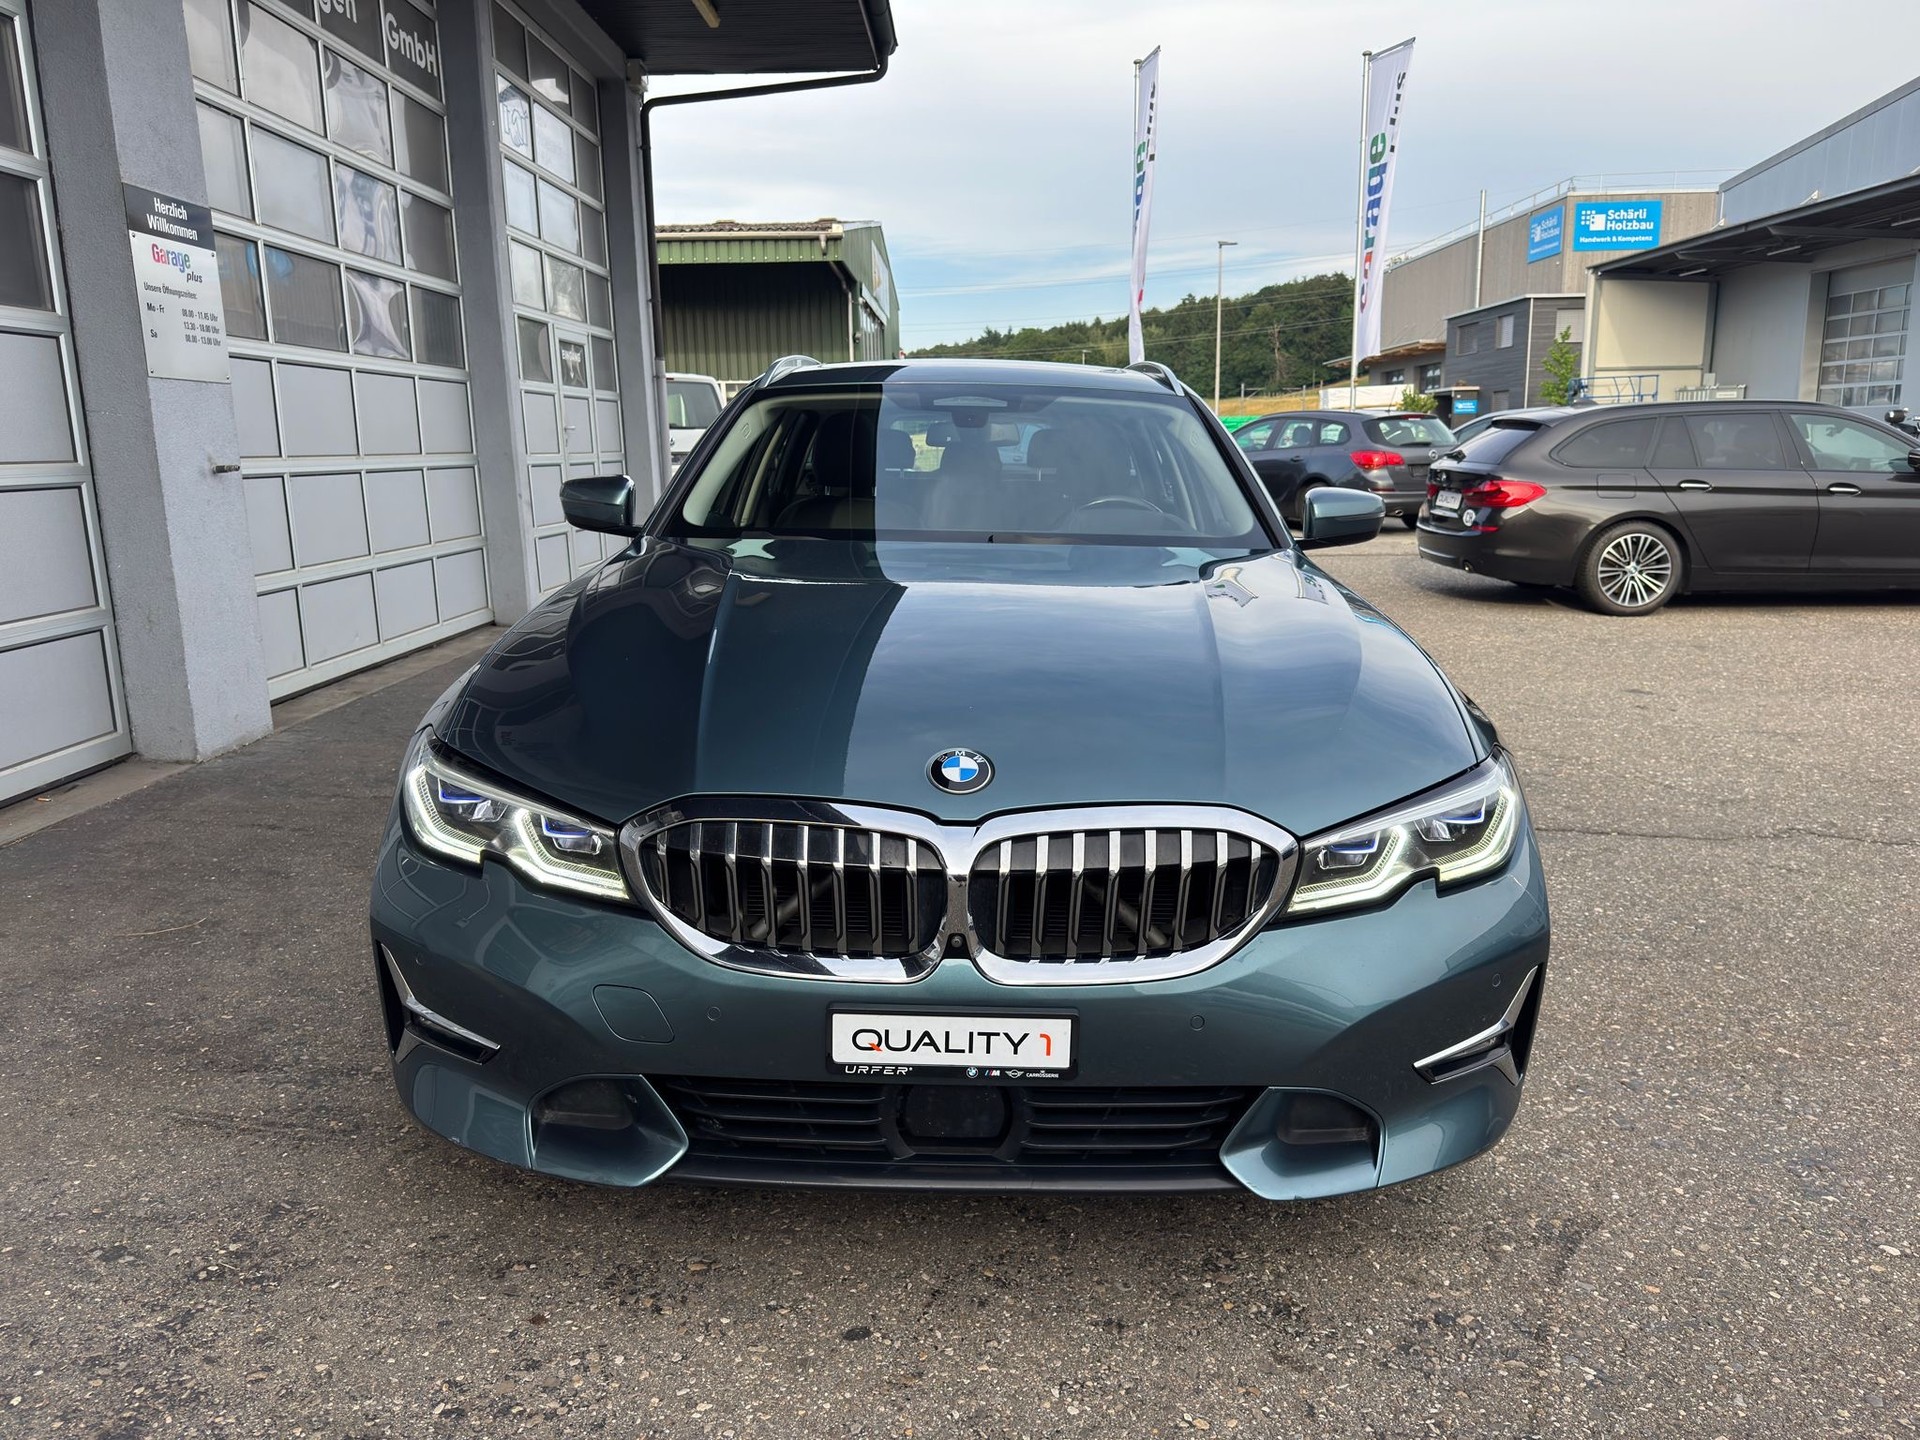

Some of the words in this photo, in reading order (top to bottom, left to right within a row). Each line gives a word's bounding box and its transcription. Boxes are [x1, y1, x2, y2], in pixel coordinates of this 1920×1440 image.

[385, 12, 438, 77] GmbH
[154, 197, 188, 220] Herzlich
[1607, 208, 1647, 220] Schärli
[146, 213, 198, 241] Willkommen
[1606, 221, 1654, 231] Holzbau
[1617, 235, 1653, 243] Kompetenz
[151, 243, 191, 273] Garage
[186, 271, 203, 284] plus
[143, 282, 162, 293] Unsere
[146, 302, 156, 312] Mo
[150, 329, 158, 339] Sa
[851, 1028, 1030, 1056] QUALITY
[1039, 1033, 1052, 1057] 1
